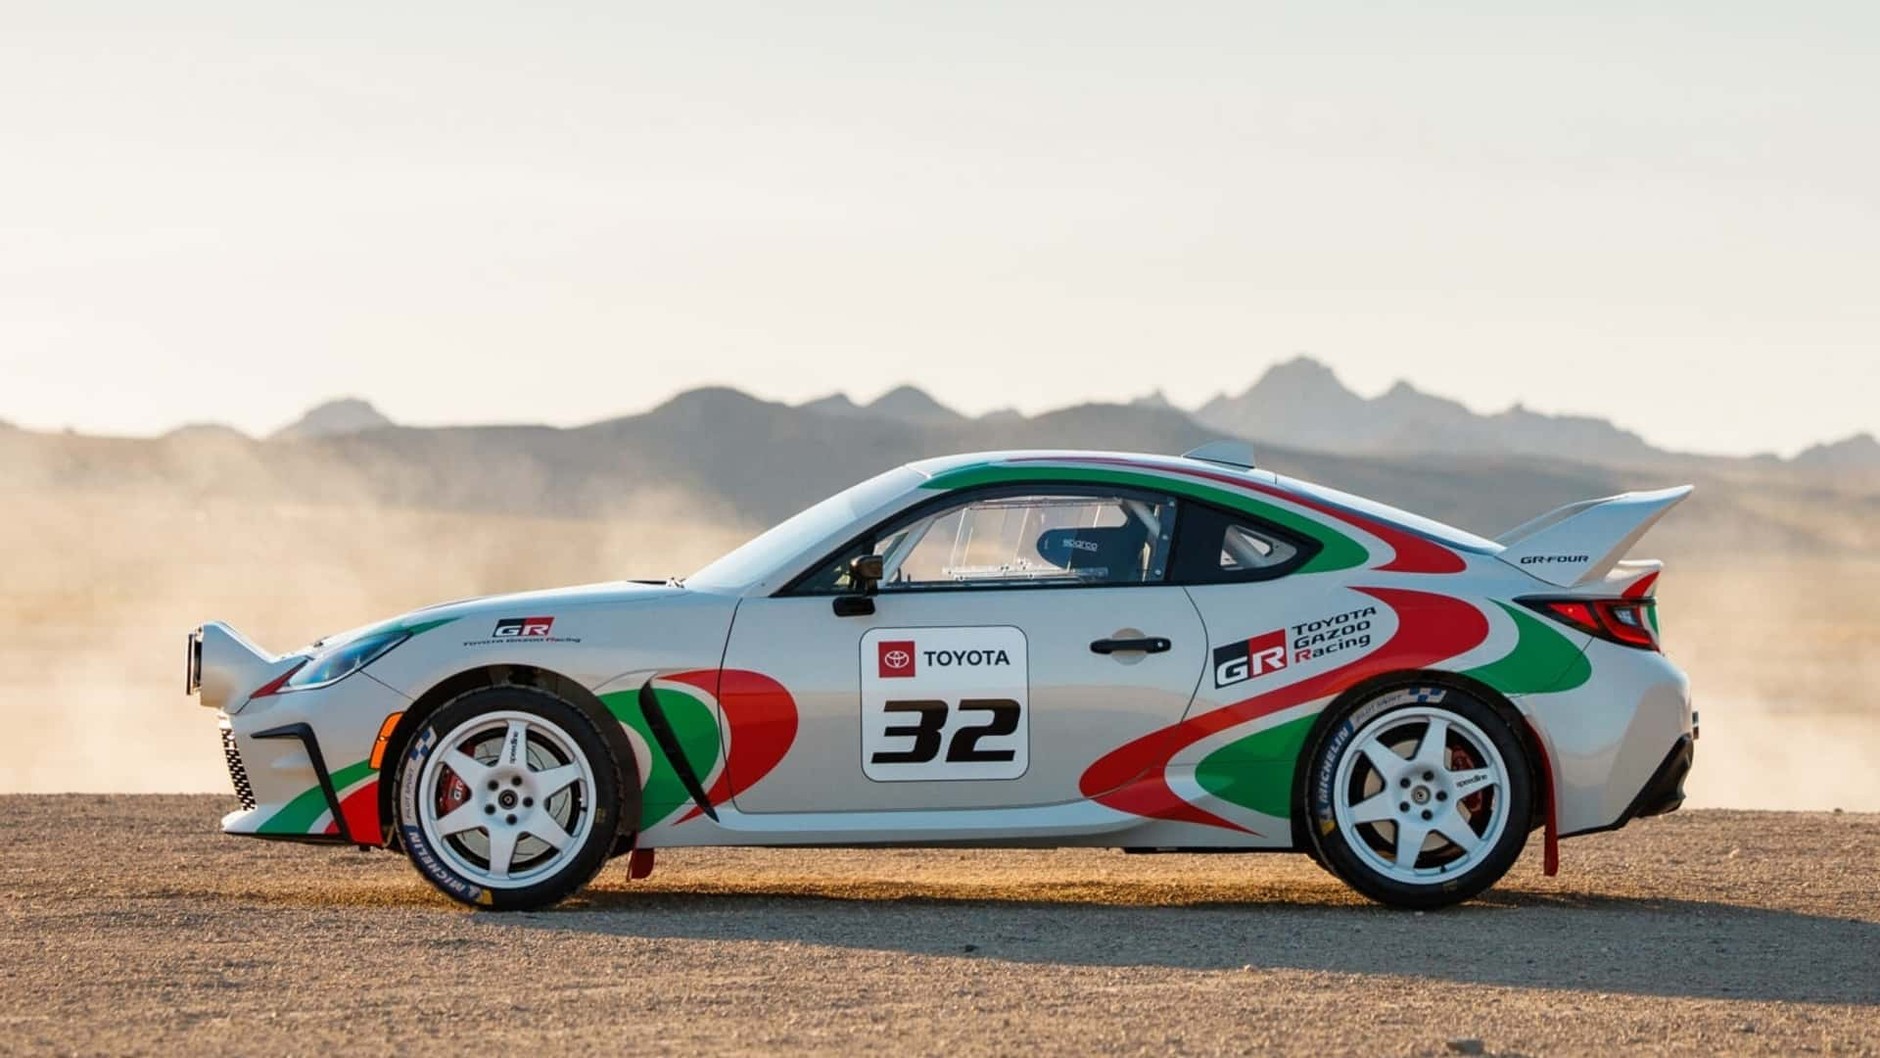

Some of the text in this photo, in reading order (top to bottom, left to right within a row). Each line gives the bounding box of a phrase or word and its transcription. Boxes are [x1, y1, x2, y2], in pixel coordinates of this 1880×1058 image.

[1063, 538, 1098, 552] sparco
[494, 624, 549, 637] GR
[1291, 606, 1378, 636] TOYOTA
[1293, 620, 1371, 650] GAZOO
[923, 649, 1011, 667] TOYOTA
[1295, 634, 1371, 664] Racing
[1216, 646, 1286, 686] GR
[871, 699, 1021, 764] 32
[1318, 726, 1350, 804] MICHELIN
[409, 832, 466, 892] MICHELIN
